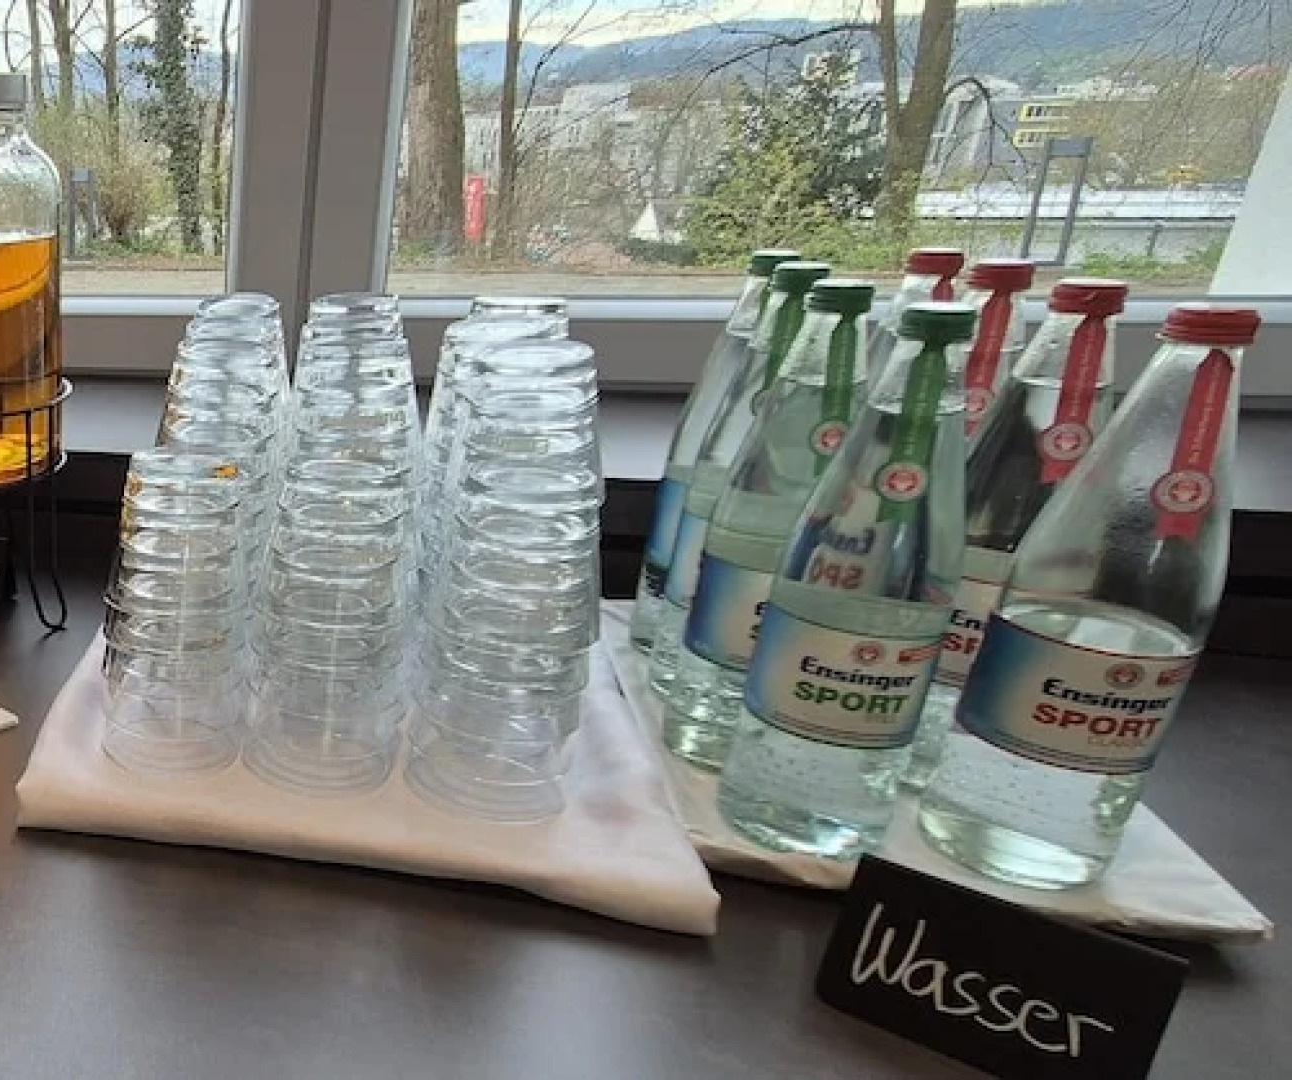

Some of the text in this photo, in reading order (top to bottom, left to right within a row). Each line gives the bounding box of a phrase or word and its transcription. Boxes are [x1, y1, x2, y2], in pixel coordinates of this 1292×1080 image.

[798, 655, 920, 691] Ensinger
[792, 681, 911, 714] SPORT
[1041, 678, 1173, 715] Ensinger
[1030, 702, 1164, 738] SPORT
[851, 901, 1115, 1058] Wasser
